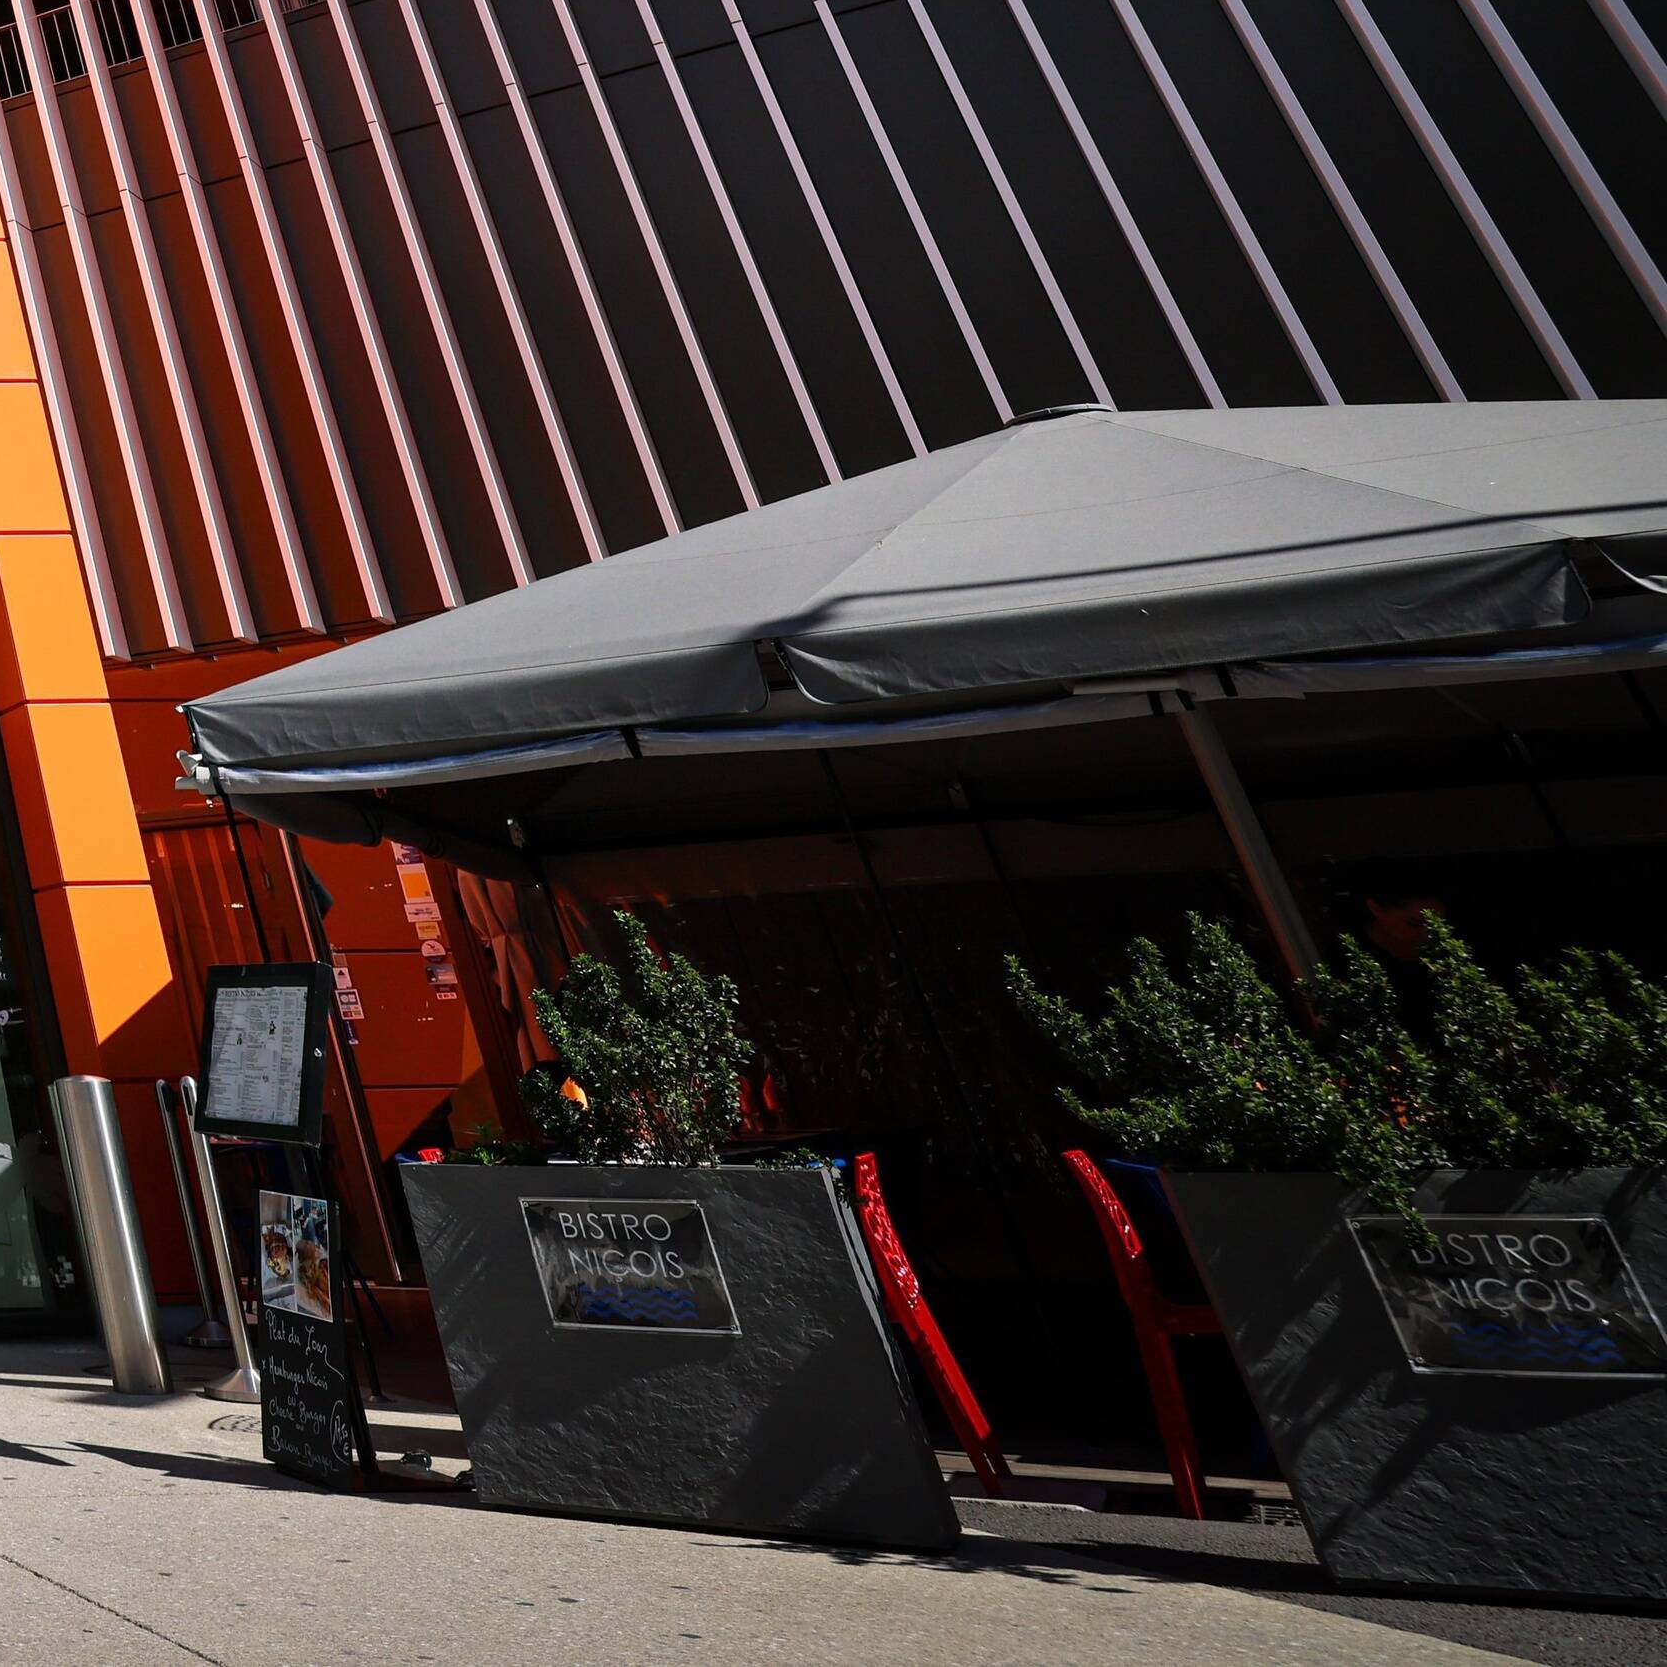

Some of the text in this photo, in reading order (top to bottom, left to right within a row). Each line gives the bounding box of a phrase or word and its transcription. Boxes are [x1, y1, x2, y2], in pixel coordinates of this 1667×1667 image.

[558, 1212, 673, 1242] BISTRO
[568, 1248, 685, 1282] NIÇOIS
[1431, 1279, 1597, 1315] NIÇOIS
[267, 1309, 300, 1346] Plat du
